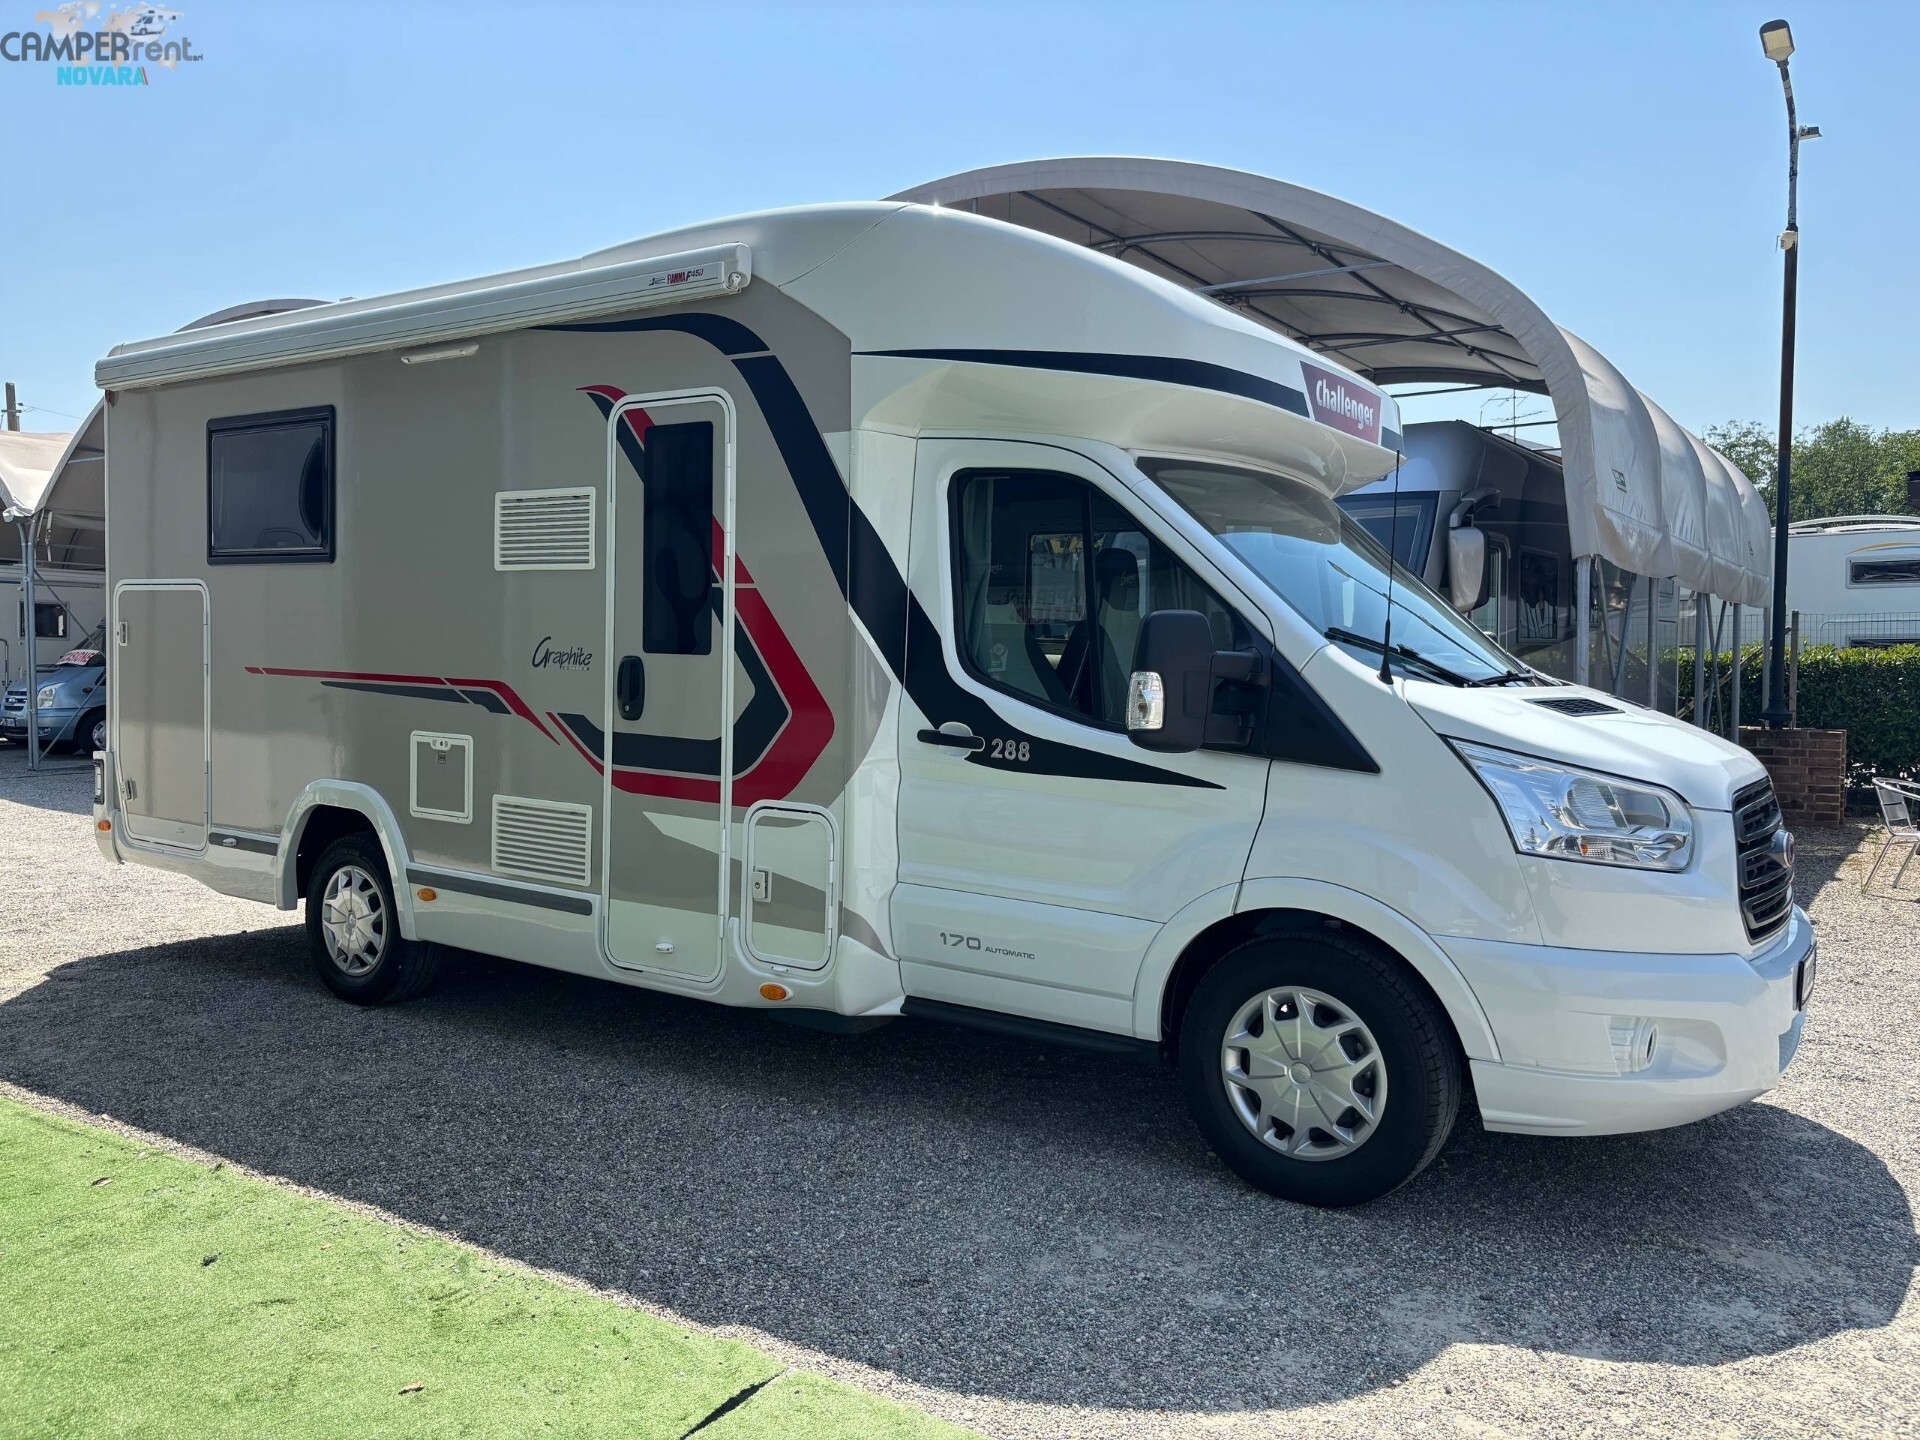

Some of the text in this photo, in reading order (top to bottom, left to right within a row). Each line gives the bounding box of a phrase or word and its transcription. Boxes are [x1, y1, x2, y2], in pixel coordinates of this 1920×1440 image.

[1315, 378, 1374, 430] Challenger
[531, 635, 593, 670] Graphite
[990, 737, 1030, 762] 288
[939, 931, 1036, 960] 170 AUTOMATIC
